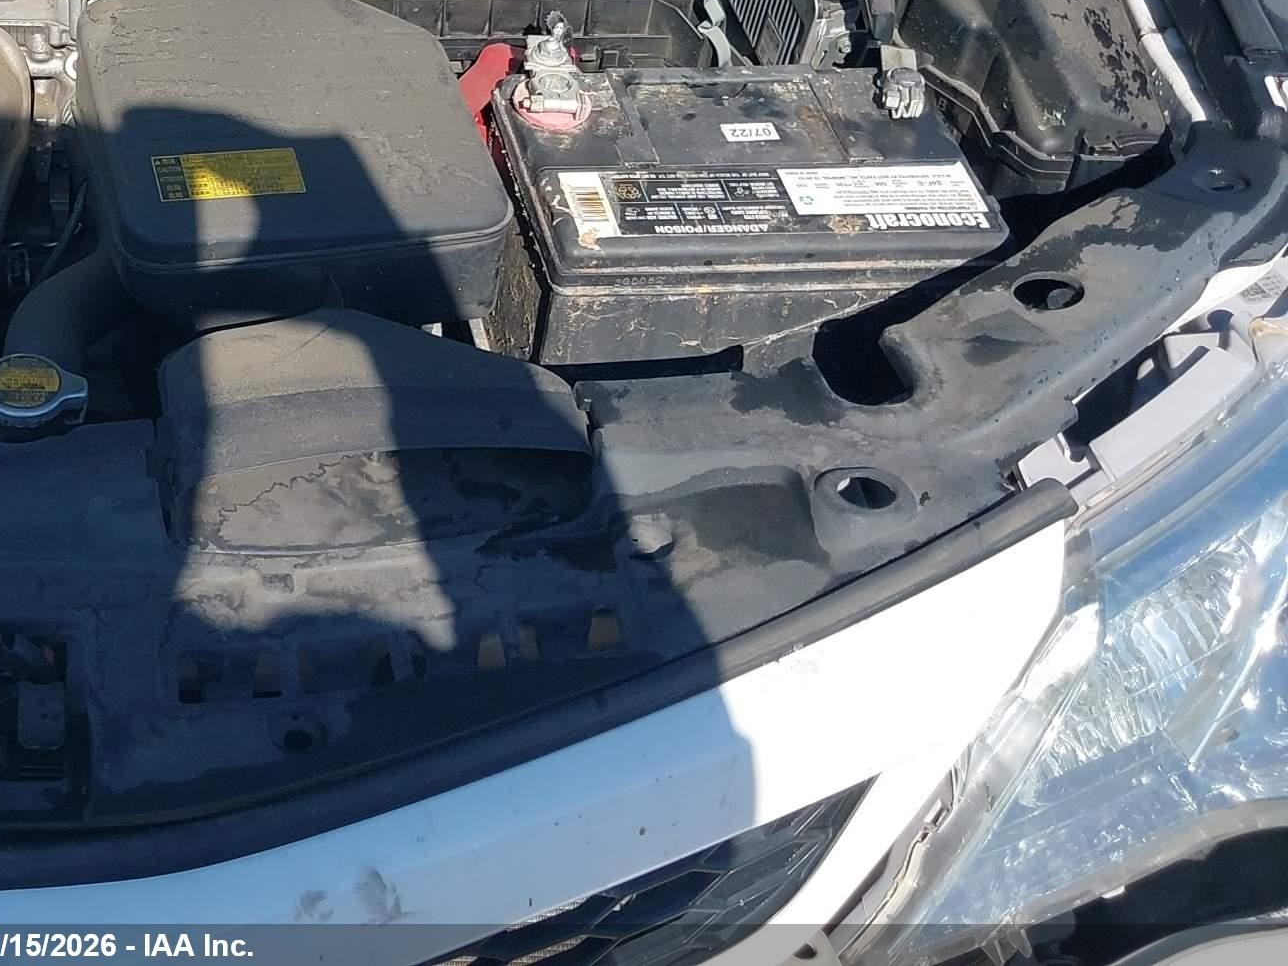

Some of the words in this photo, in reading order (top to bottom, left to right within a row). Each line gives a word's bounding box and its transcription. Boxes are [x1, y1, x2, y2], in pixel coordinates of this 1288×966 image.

[729, 128, 772, 137] 07/22
[865, 213, 992, 230] Econocraft
[655, 223, 761, 233] DANGER/POISON
